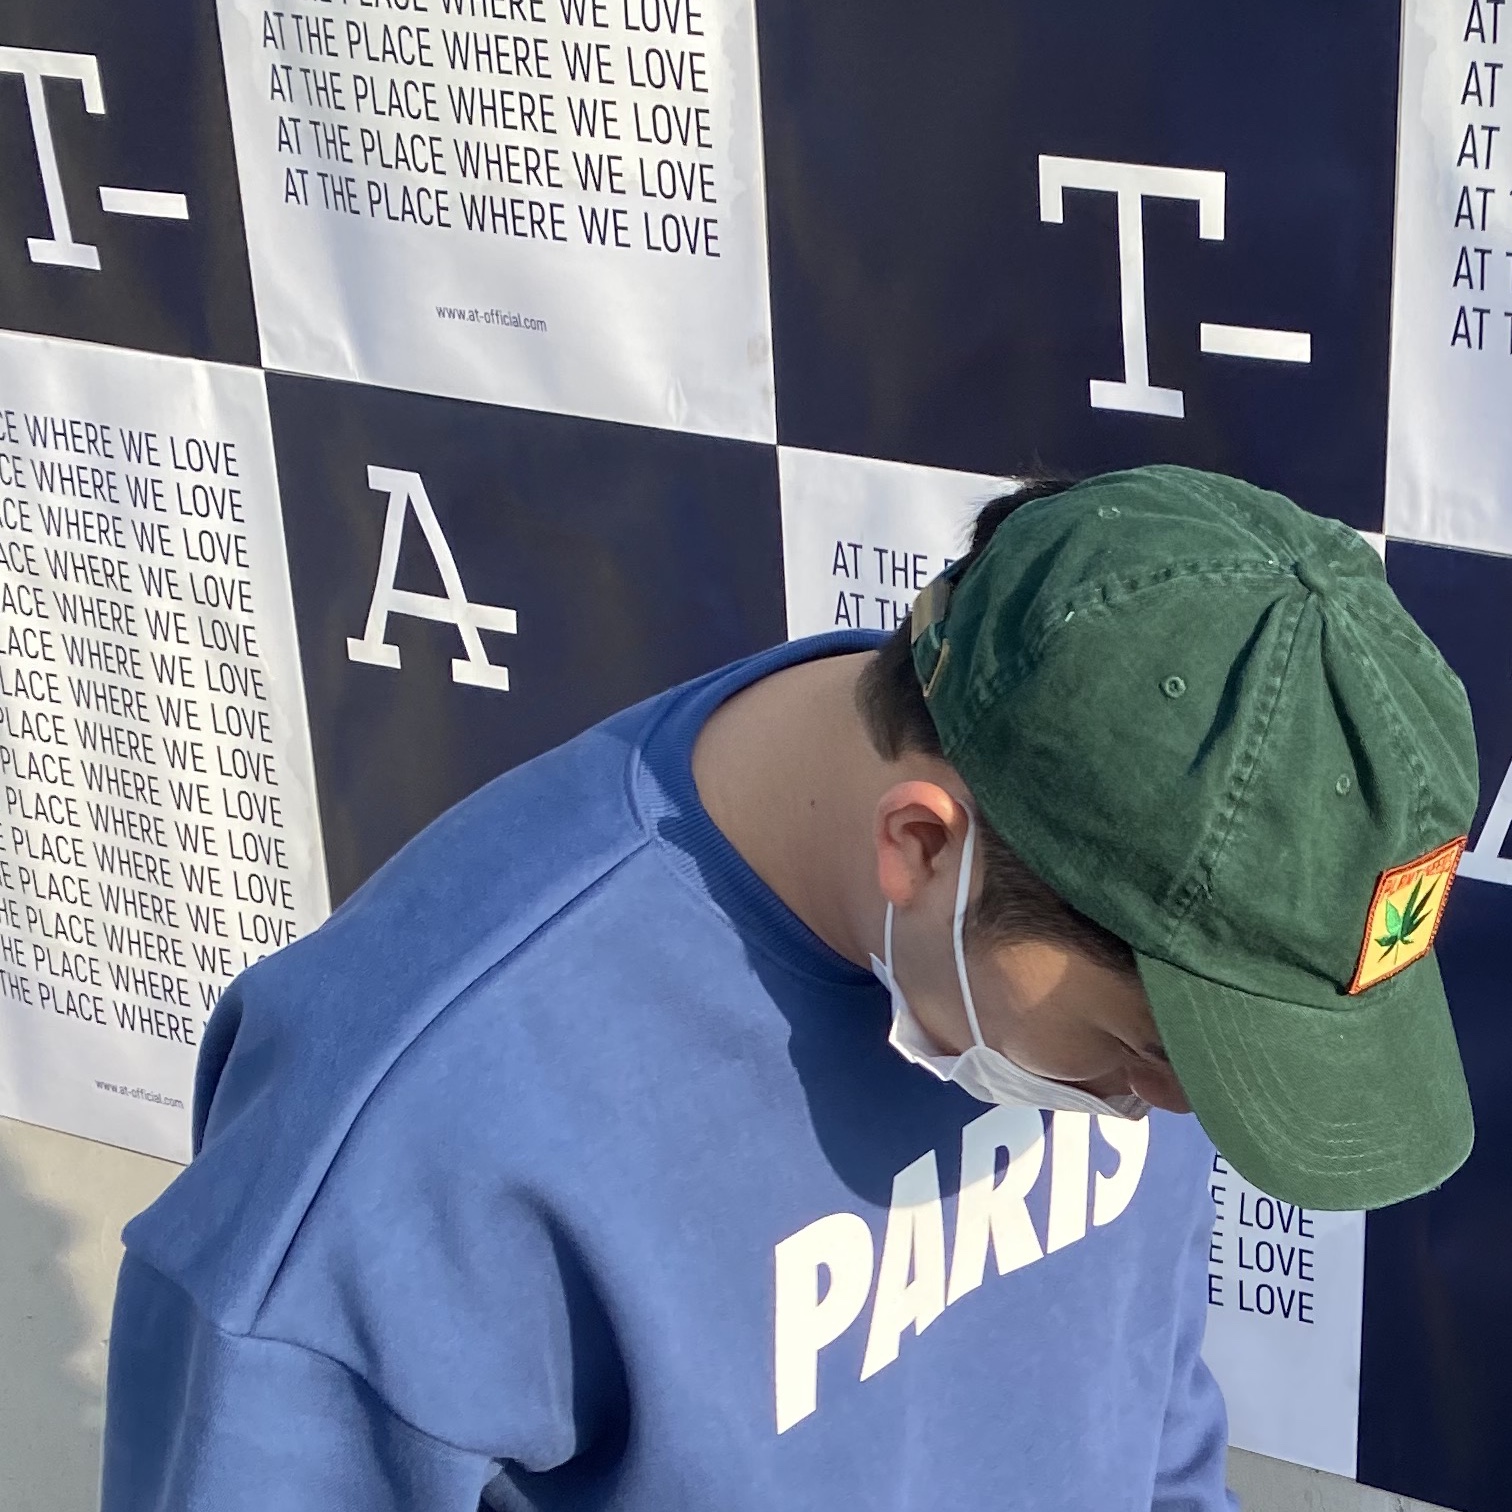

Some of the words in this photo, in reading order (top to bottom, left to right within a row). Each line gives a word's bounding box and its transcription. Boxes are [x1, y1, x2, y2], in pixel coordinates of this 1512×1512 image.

[262, 10, 286, 51] AT
[290, 13, 340, 58] THE
[344, 19, 434, 69] PLACE
[440, 28, 553, 80] WHERE
[560, 39, 616, 85] WE
[626, 46, 710, 94] LOVE
[624, 0, 705, 36] LOVE
[1462, 0, 1506, 45] AT
[269, 63, 295, 103] AT
[298, 66, 347, 111] THE
[352, 74, 441, 122] PLACE
[446, 83, 558, 136] WHERE
[565, 96, 622, 142] WE
[632, 101, 713, 149] LOVE
[1460, 60, 1505, 109] AT
[284, 166, 310, 206] AT
[316, 171, 361, 216] THE
[366, 180, 453, 229] PLACE
[458, 191, 568, 243] WHERE
[577, 204, 632, 249] WE
[643, 210, 721, 259] LOVE
[1453, 184, 1496, 232] AT
[435, 305, 548, 332] www.at-official.com
[1449, 305, 1492, 351] AT
[29, 458, 121, 505] WHERE
[124, 473, 168, 513] WE
[175, 481, 246, 524] LOVE
[346, 464, 518, 692] A
[832, 540, 863, 580] AT
[873, 547, 928, 591] THE
[0, 581, 51, 620] ACE
[51, 590, 139, 639] WHERE
[143, 606, 191, 646] WE
[197, 615, 260, 659] LOVE
[834, 590, 865, 629] AT
[875, 597, 913, 630] TH
[0, 667, 63, 706] LACE
[66, 675, 151, 724] WHERE
[154, 693, 203, 732] WE
[209, 701, 274, 744] LOVE
[0, 745, 76, 789] PLACE
[79, 758, 163, 808] WHERE
[167, 778, 214, 817] WE
[221, 786, 285, 830] LOVE
[4, 785, 82, 829] PLACE
[85, 800, 169, 849] WHERE
[172, 820, 220, 857] WE
[227, 828, 290, 871] LOVE
[17, 864, 94, 909] PLACE
[97, 880, 181, 930] WHERE
[184, 901, 230, 939] WE
[237, 910, 297, 947] LOVE
[0, 935, 28, 969] HE
[31, 942, 103, 988] PLACE
[106, 960, 192, 1009] WHERE
[197, 979, 229, 1012] W
[0, 971, 34, 1006] THE
[37, 981, 108, 1027] PLACE
[111, 999, 197, 1047] WHERE
[1239, 1191, 1315, 1239] LOVE
[774, 1104, 1150, 1436] PARIS
[1238, 1236, 1315, 1282] LOVE
[1238, 1279, 1315, 1325] LOVE
